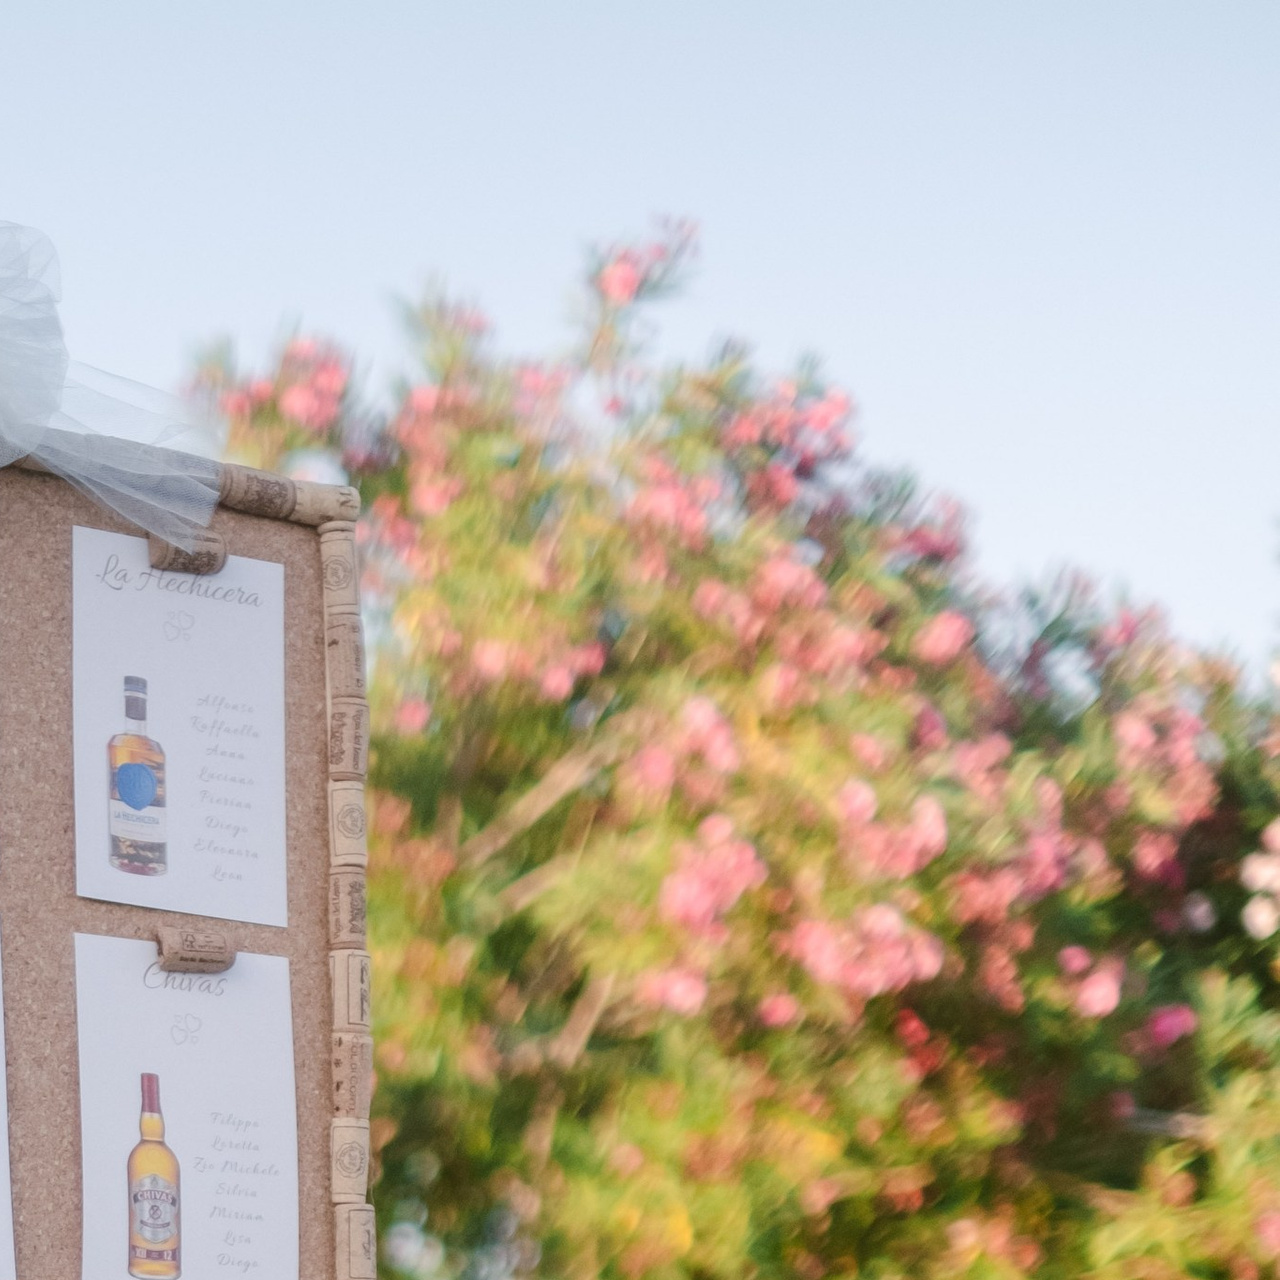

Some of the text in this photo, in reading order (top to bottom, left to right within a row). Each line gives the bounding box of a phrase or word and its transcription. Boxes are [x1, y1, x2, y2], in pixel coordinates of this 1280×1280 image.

[96, 553, 264, 608] La Hechicera
[205, 815, 248, 838] Diego
[143, 960, 229, 998] Chivas
[137, 1190, 173, 1203] CHIVAS
[163, 1250, 173, 1261] 12
[217, 1253, 259, 1274] Diego
